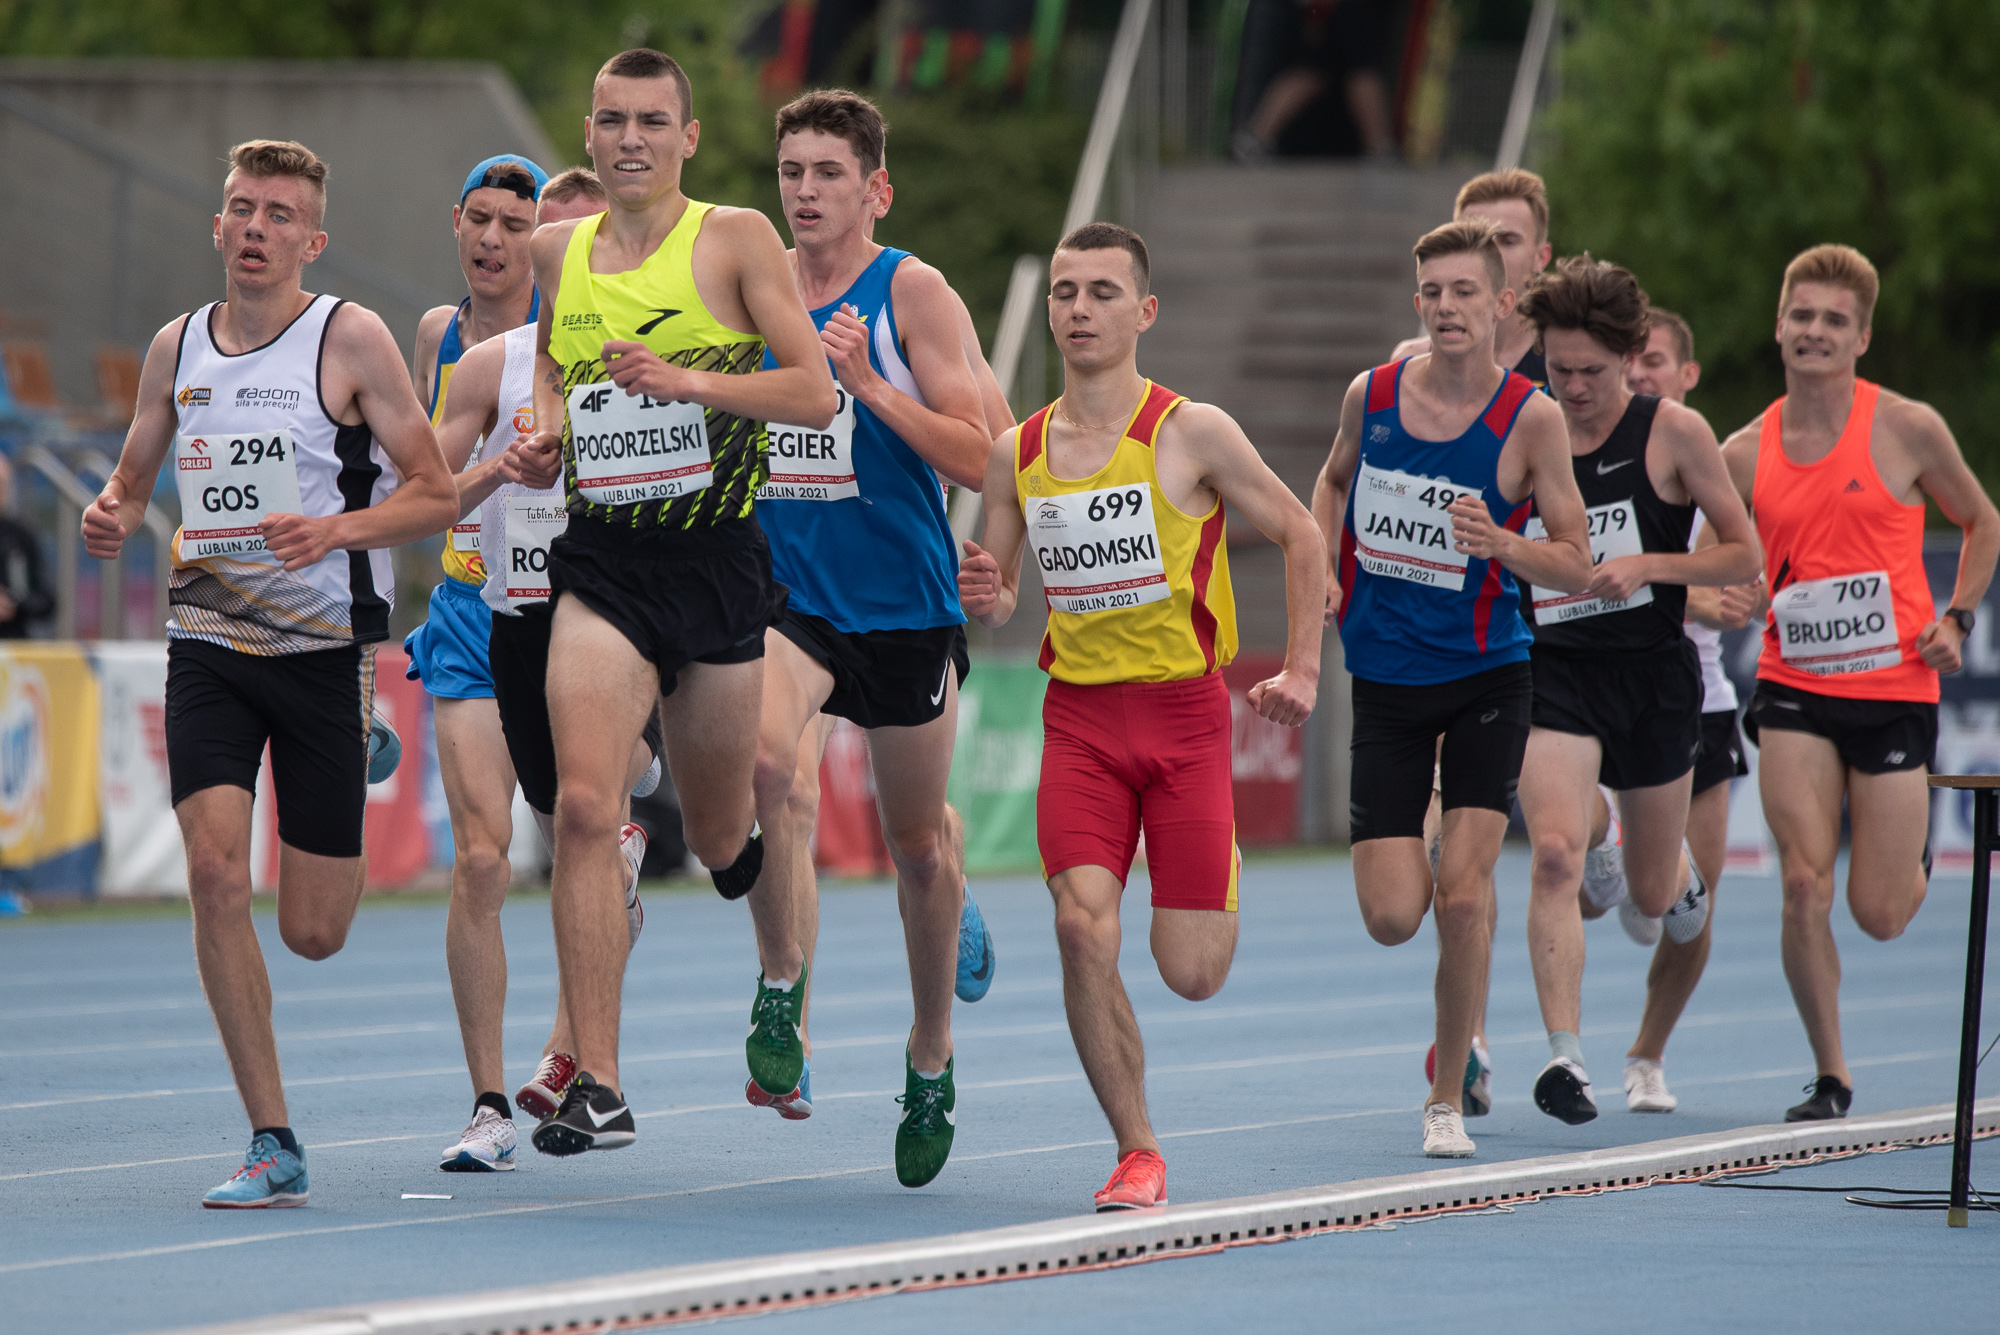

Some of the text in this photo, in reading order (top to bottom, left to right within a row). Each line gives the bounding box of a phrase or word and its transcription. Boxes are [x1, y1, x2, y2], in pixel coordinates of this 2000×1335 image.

[562, 314, 603, 326] BEASTS
[262, 401, 298, 410] precyzji
[579, 389, 612, 412] 4F
[229, 436, 285, 466] 294
[576, 423, 702, 462] POGORZELSKI
[180, 458, 210, 469] ORLEN
[609, 473, 661, 484] MISTRZOSTWA
[662, 468, 690, 478] POLSKI
[691, 464, 707, 472] U20
[202, 484, 259, 513] GOS
[603, 482, 683, 503] LUBLIN 2021
[799, 487, 828, 498] 2021
[1418, 487, 1470, 511] 49
[527, 507, 553, 519] lublin
[1041, 510, 1058, 519] PGE
[1088, 490, 1143, 522] 699
[204, 528, 256, 538] MISTRZOSTWA
[1365, 513, 1447, 550] JANTA
[197, 539, 268, 555] LUBLIN 202
[1038, 534, 1156, 571] GADOMSKI
[1363, 558, 1435, 584] LUBLIN 2021
[1071, 584, 1118, 594] MISTRZOSTWA
[1119, 580, 1144, 588] POLSKI
[1832, 577, 1881, 604] 707
[1067, 592, 1140, 612] LUBLIN 2021
[1558, 604, 1598, 620] LUBLIN
[1786, 612, 1885, 645] BRUDŁO
[1848, 658, 1875, 673] 2021
